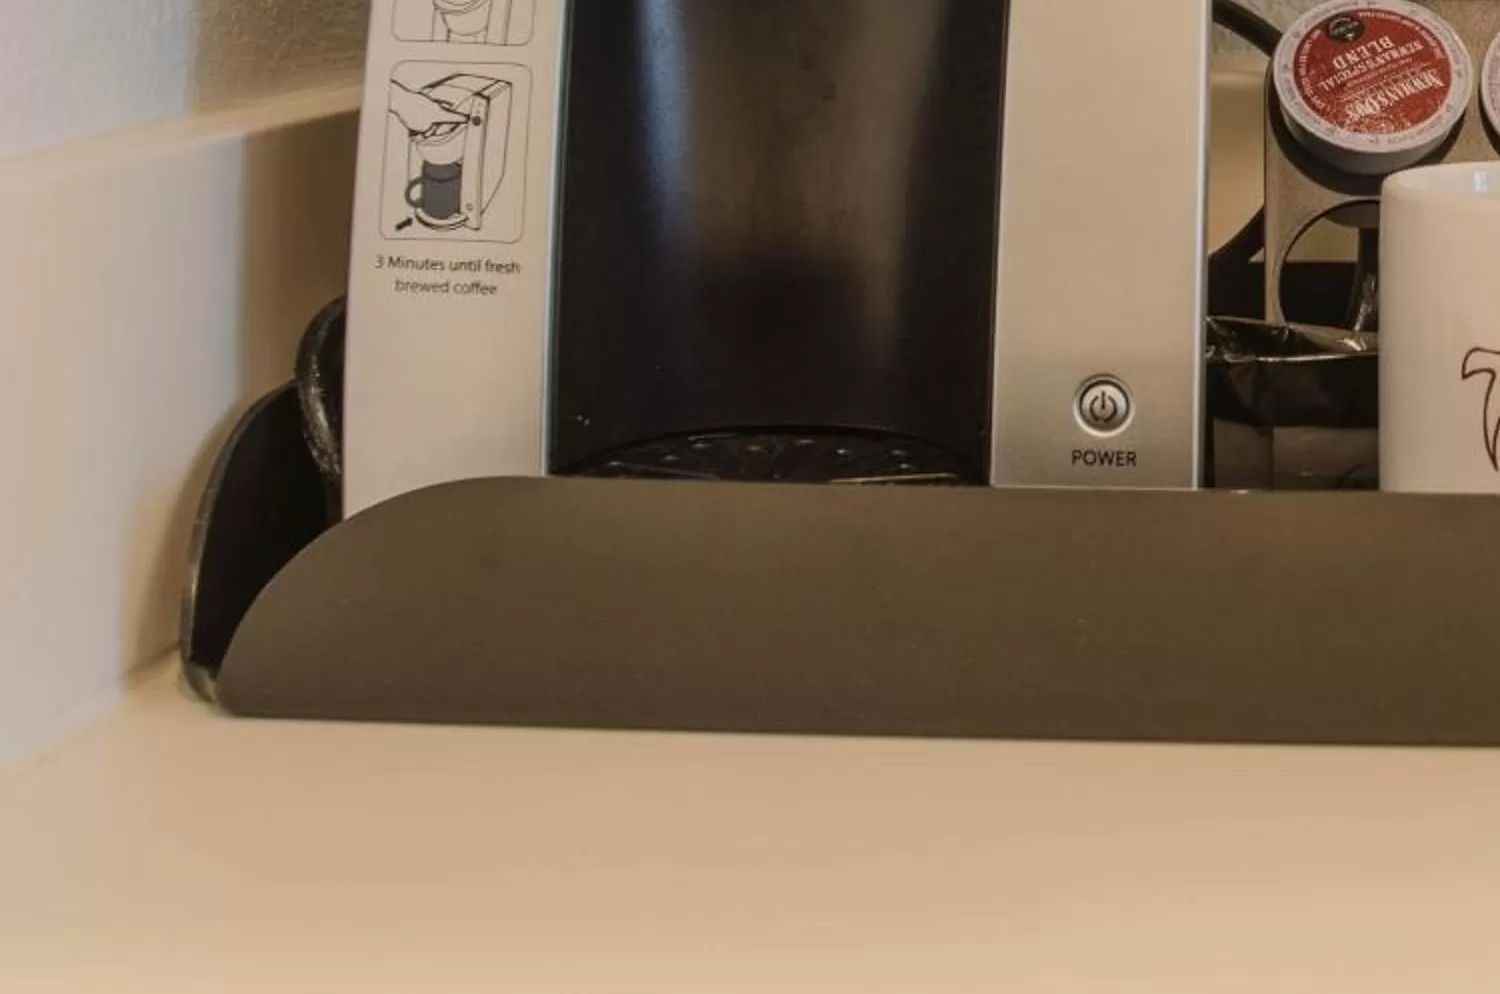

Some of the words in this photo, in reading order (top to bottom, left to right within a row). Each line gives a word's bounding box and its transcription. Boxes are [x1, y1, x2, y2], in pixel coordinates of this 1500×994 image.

[1331, 35, 1394, 70] BLEND
[375, 255, 384, 269] 3
[387, 256, 445, 271] Minutes
[449, 257, 481, 272] until
[484, 258, 521, 274] fresh
[394, 279, 449, 294] brewed
[453, 281, 497, 295] coffee
[1071, 449, 1137, 467] POWER
